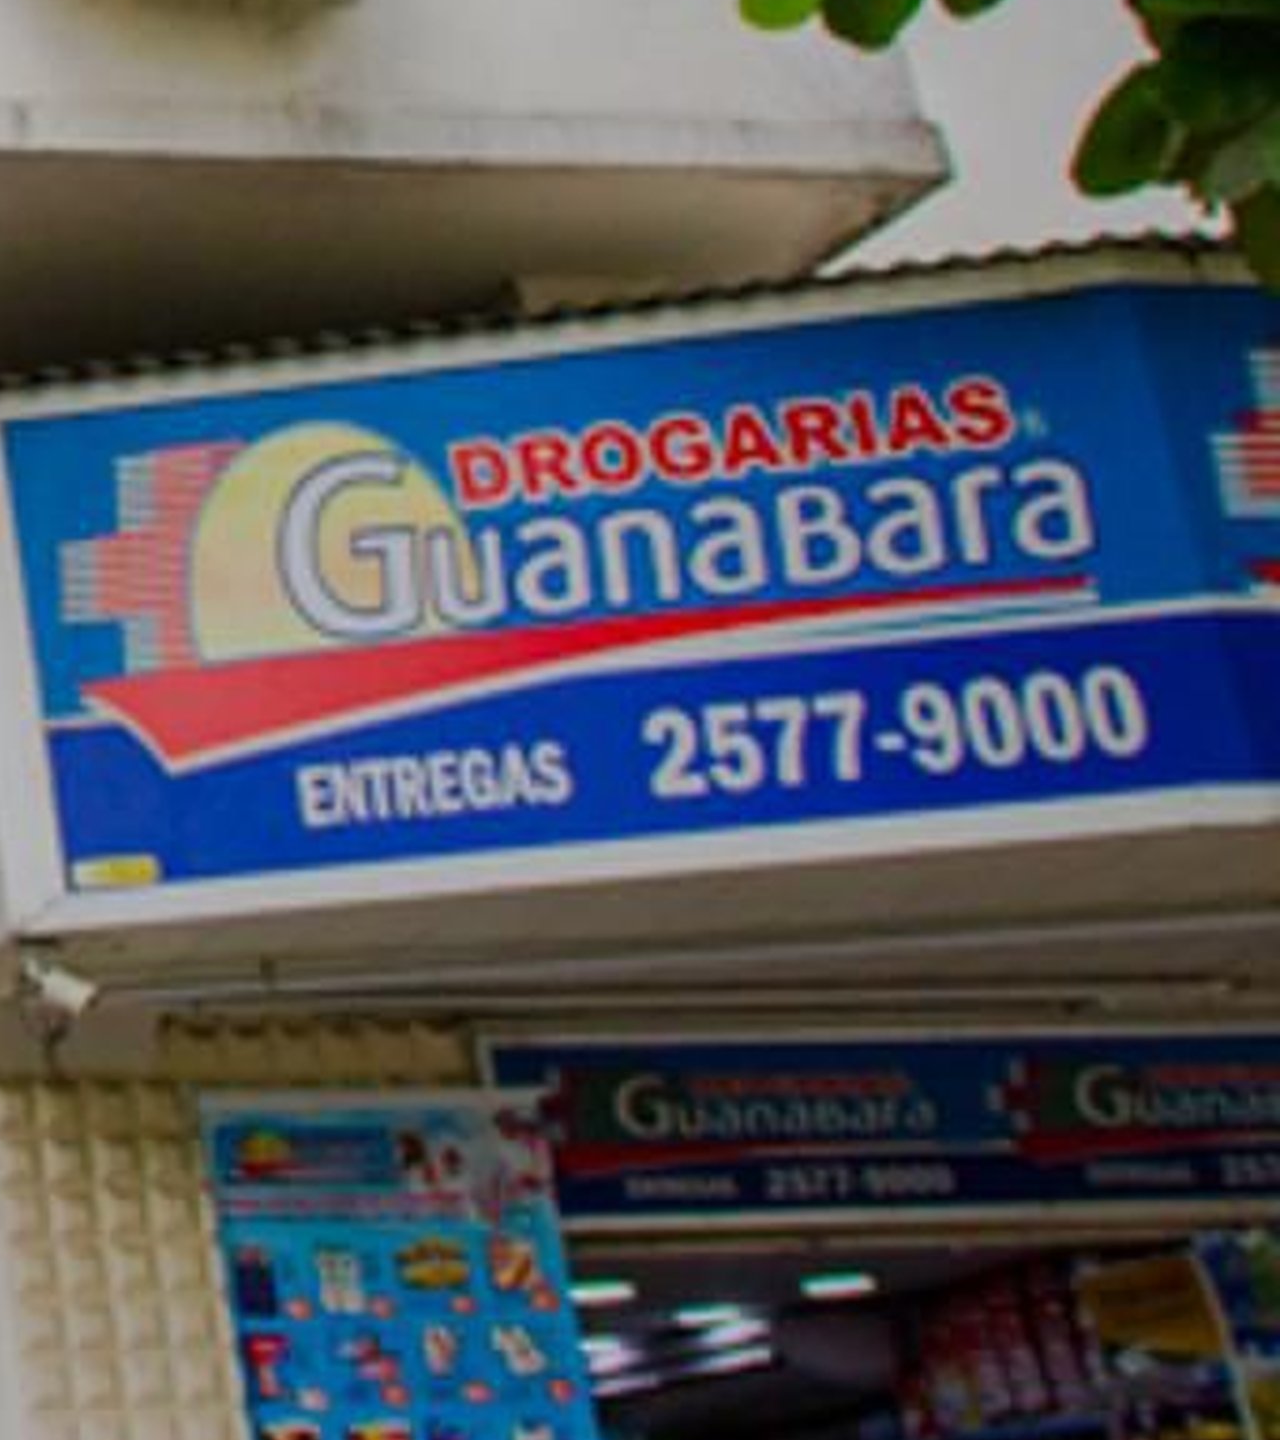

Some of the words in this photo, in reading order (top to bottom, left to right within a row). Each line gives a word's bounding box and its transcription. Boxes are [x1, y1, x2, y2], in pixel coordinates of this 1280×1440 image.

[450, 375, 1014, 509] DROGARIAS
[297, 740, 573, 828] ENTREGAS
[643, 665, 1147, 798] 2577-9000
